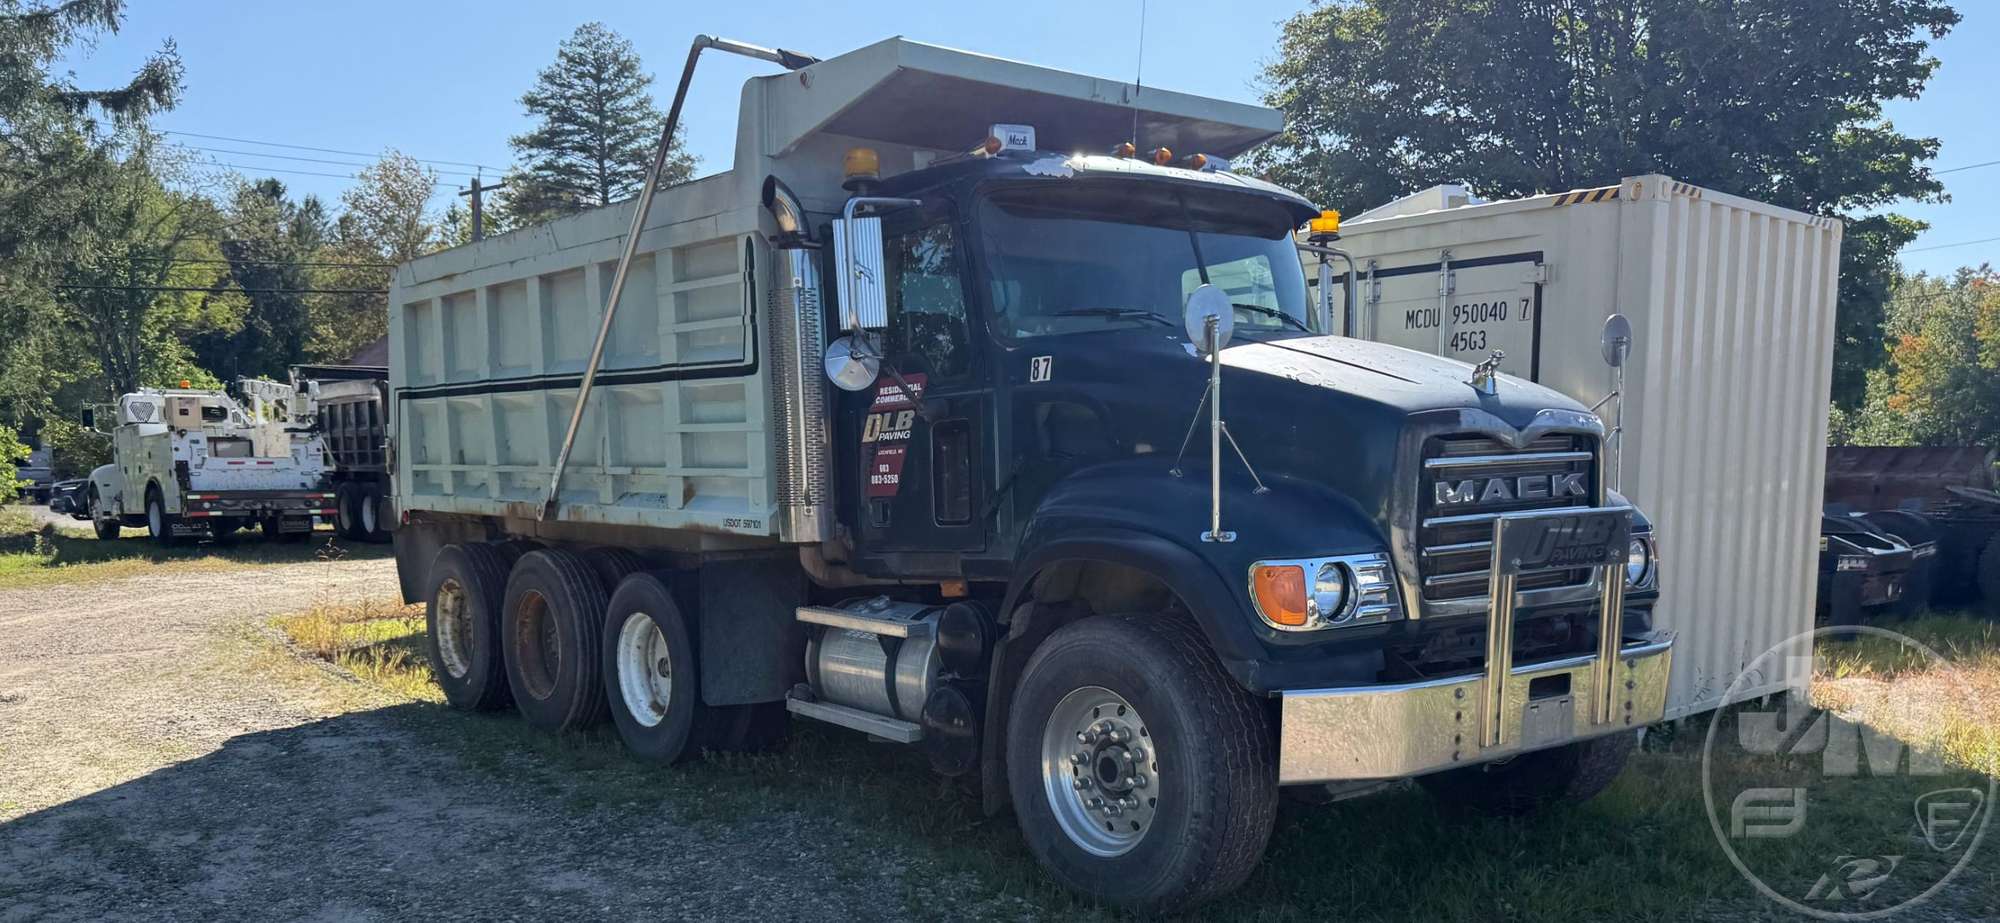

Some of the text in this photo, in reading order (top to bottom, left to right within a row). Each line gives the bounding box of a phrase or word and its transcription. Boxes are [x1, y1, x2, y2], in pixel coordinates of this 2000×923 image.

[1405, 299, 1530, 329] MCDU 950040 7
[1451, 330, 1486, 351] 45G3
[1032, 358, 1050, 380] 87
[880, 383, 922, 395] RESIDTIAL
[862, 409, 915, 442] DLB
[879, 430, 911, 441] PAVING
[1435, 473, 1585, 504] MACK
